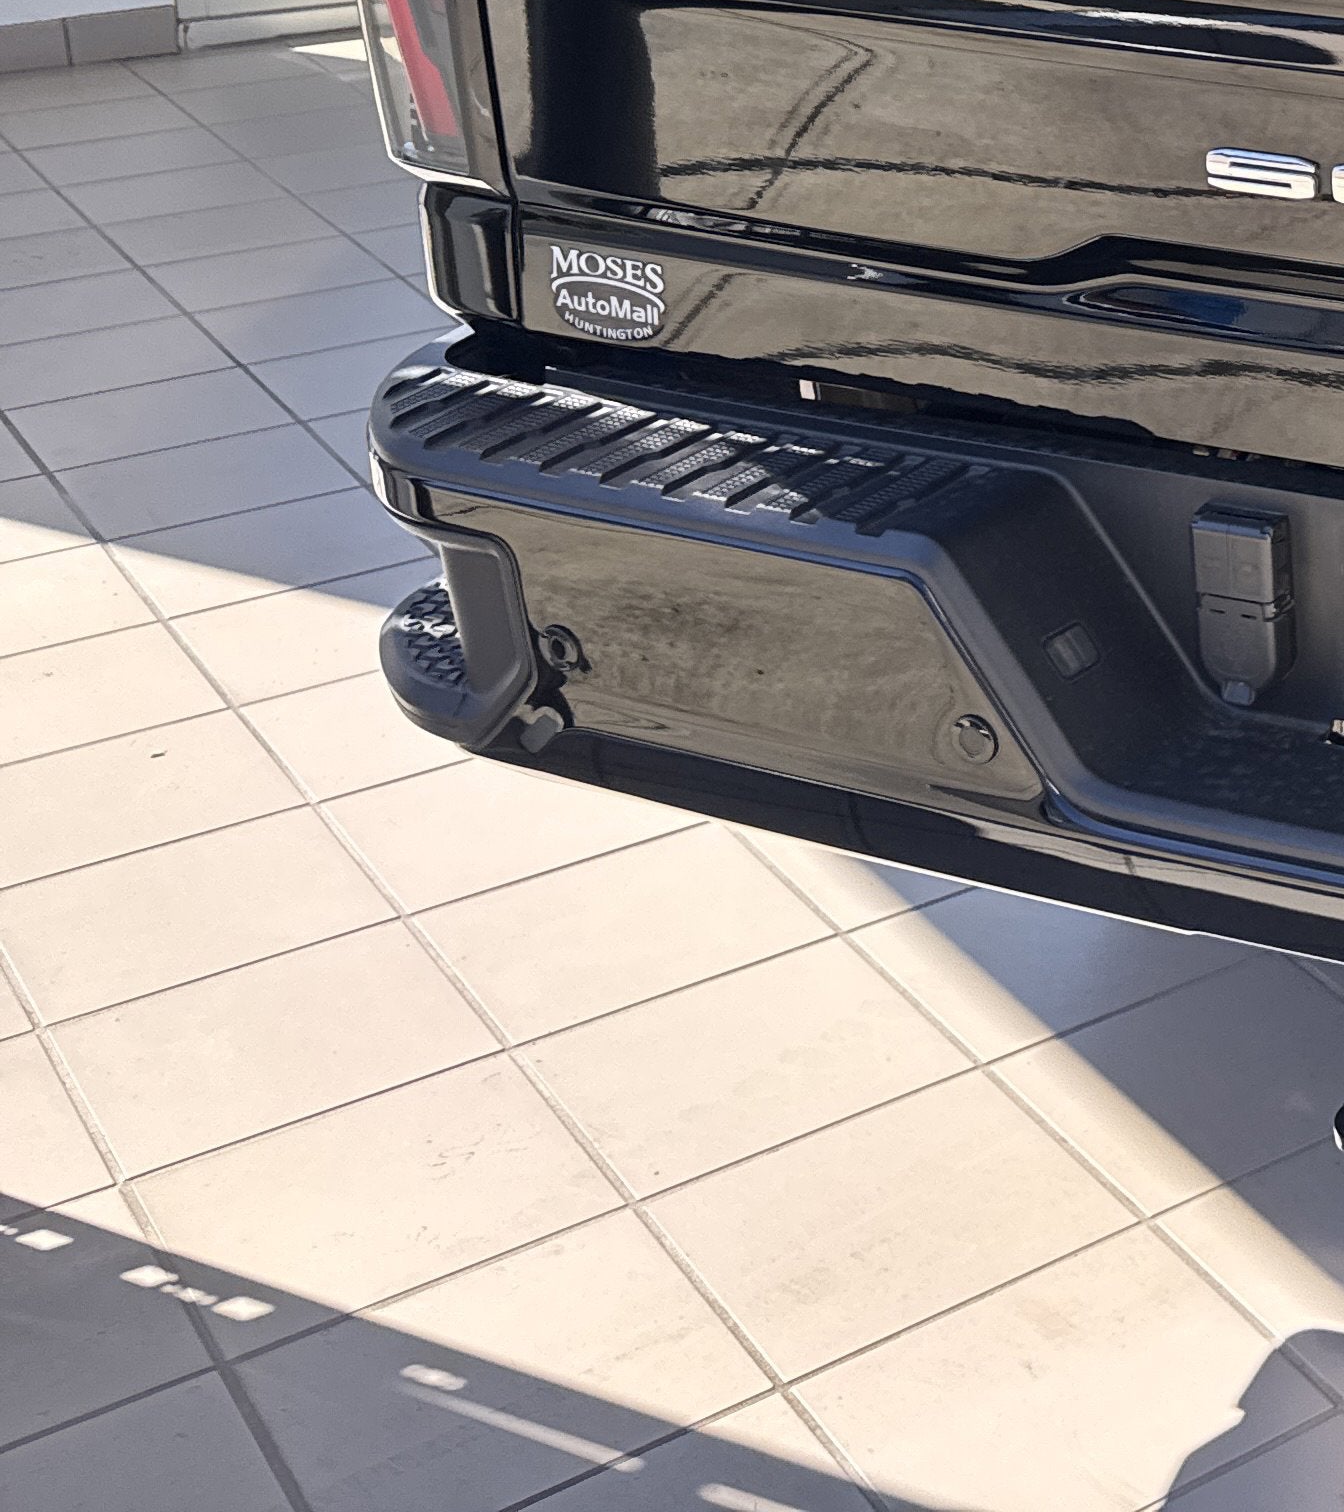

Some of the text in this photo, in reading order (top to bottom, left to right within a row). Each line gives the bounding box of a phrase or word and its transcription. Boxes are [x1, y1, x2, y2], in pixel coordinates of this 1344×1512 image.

[550, 245, 665, 295] MOSES
[556, 288, 660, 326] AutoMall
[564, 310, 654, 340] HUNTINGTON
